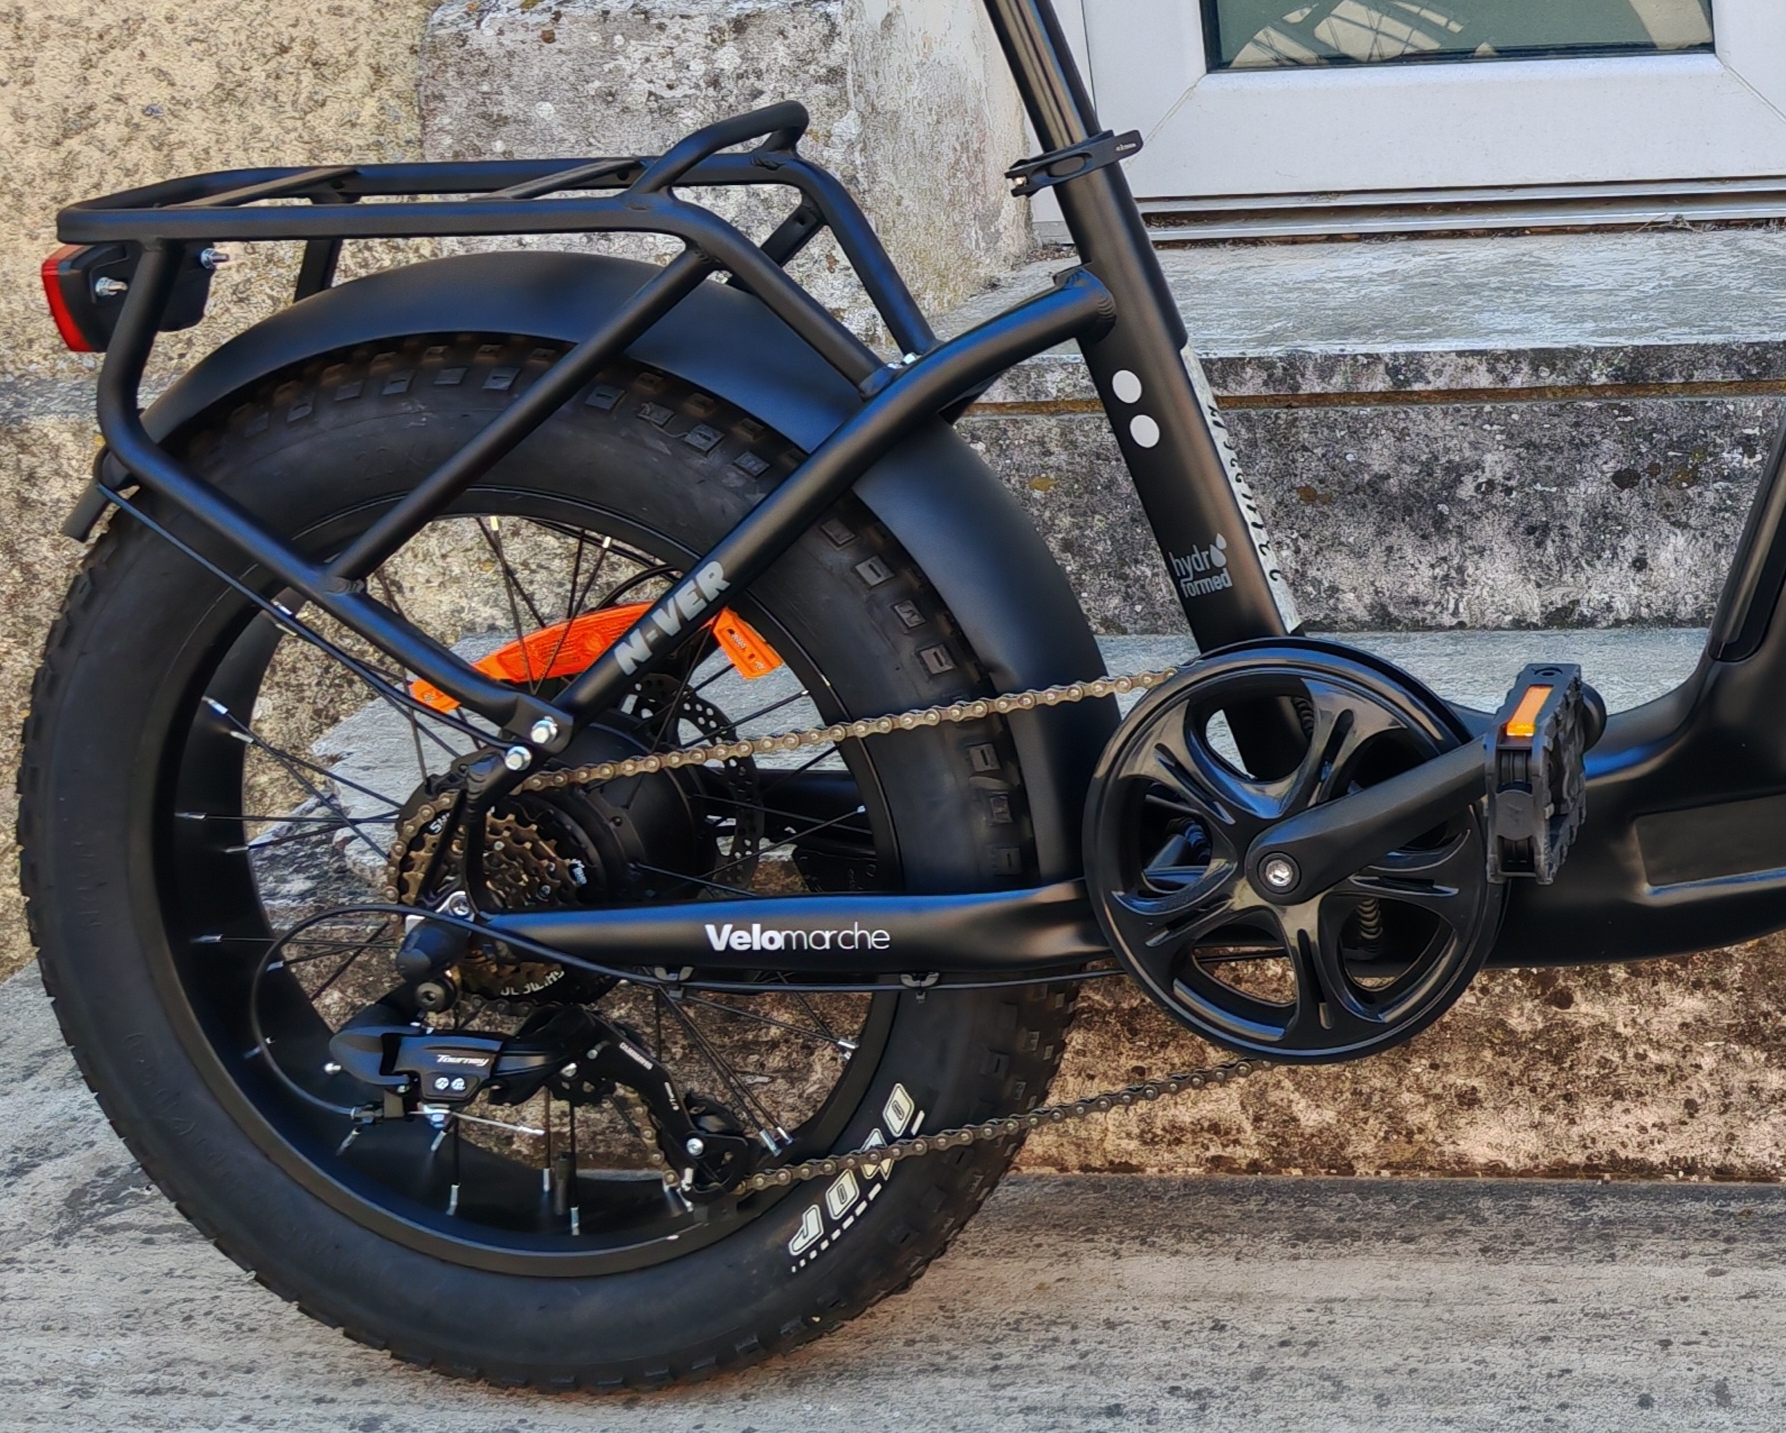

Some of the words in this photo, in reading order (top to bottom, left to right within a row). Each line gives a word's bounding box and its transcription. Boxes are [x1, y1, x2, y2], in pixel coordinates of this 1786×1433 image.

[1180, 567, 1234, 599] formed
[614, 561, 731, 676] N-VER
[705, 921, 891, 952] Velomarche
